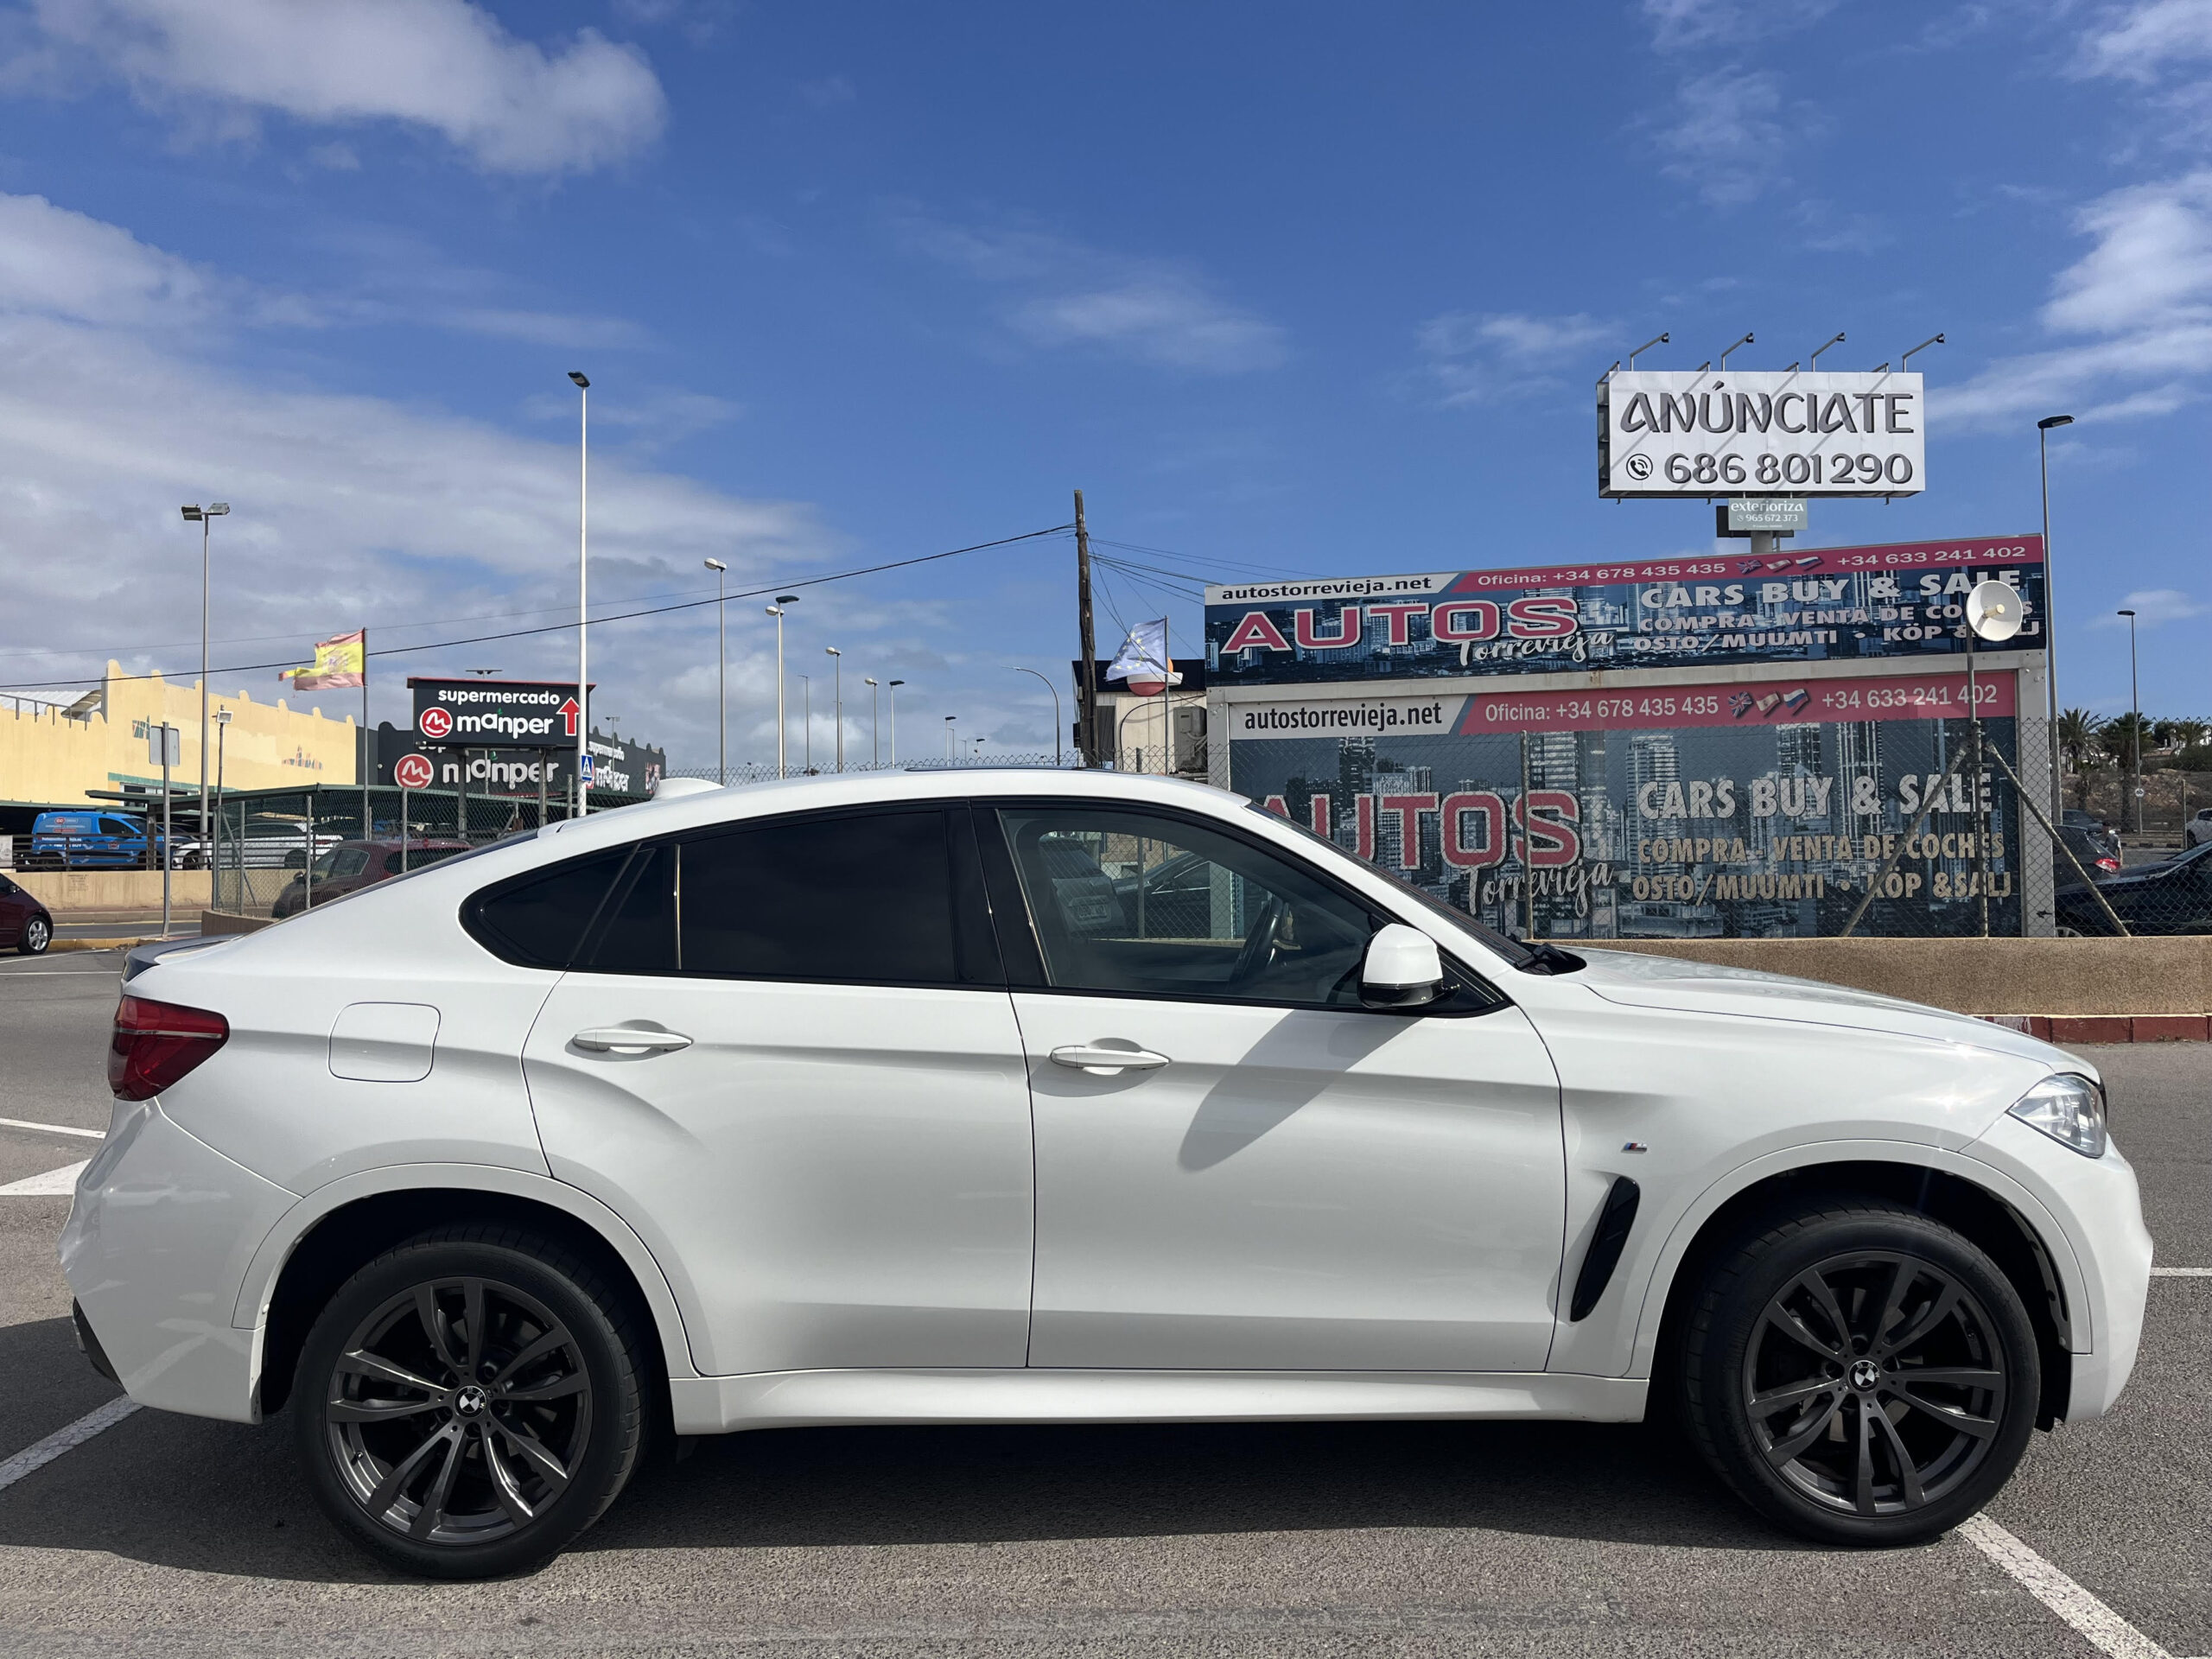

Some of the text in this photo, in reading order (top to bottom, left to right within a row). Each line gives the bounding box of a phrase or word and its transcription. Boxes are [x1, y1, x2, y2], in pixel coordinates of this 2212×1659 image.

[1619, 379, 1915, 434] ANÚNCIATE
[1664, 453, 1914, 484] 686 801 290
[1730, 500, 1804, 512] exterioriza
[1745, 513, 1798, 522] 965 672 373
[1837, 545, 2026, 567] +34 633 241 402
[1221, 575, 1433, 600] autostorrevieja.net
[1477, 562, 1726, 588] Oficina: +34 678 435 435
[1641, 583, 1745, 609] CARS
[1762, 578, 1850, 604] BUY
[1868, 576, 1902, 599] &
[1220, 596, 1582, 654] AUTOS
[1641, 601, 2033, 632] COMPRA VENTA DE COS
[1883, 622, 1942, 642] KÖP
[1452, 631, 1615, 666] Torrevieja
[437, 689, 561, 706] supermercado
[1484, 695, 1719, 722] Oficina: +34 678 435 435
[1822, 683, 1999, 709] +34 633 241 402
[456, 713, 555, 740] manper
[1244, 702, 1443, 732] autostorrevieja.net
[1639, 772, 1993, 820] CARS BUY & SALE
[1638, 837, 1748, 864] COMPRA
[1772, 834, 1855, 861] VENTA
[1863, 833, 1897, 861] DE
[1460, 859, 1615, 918] Torrevieja
